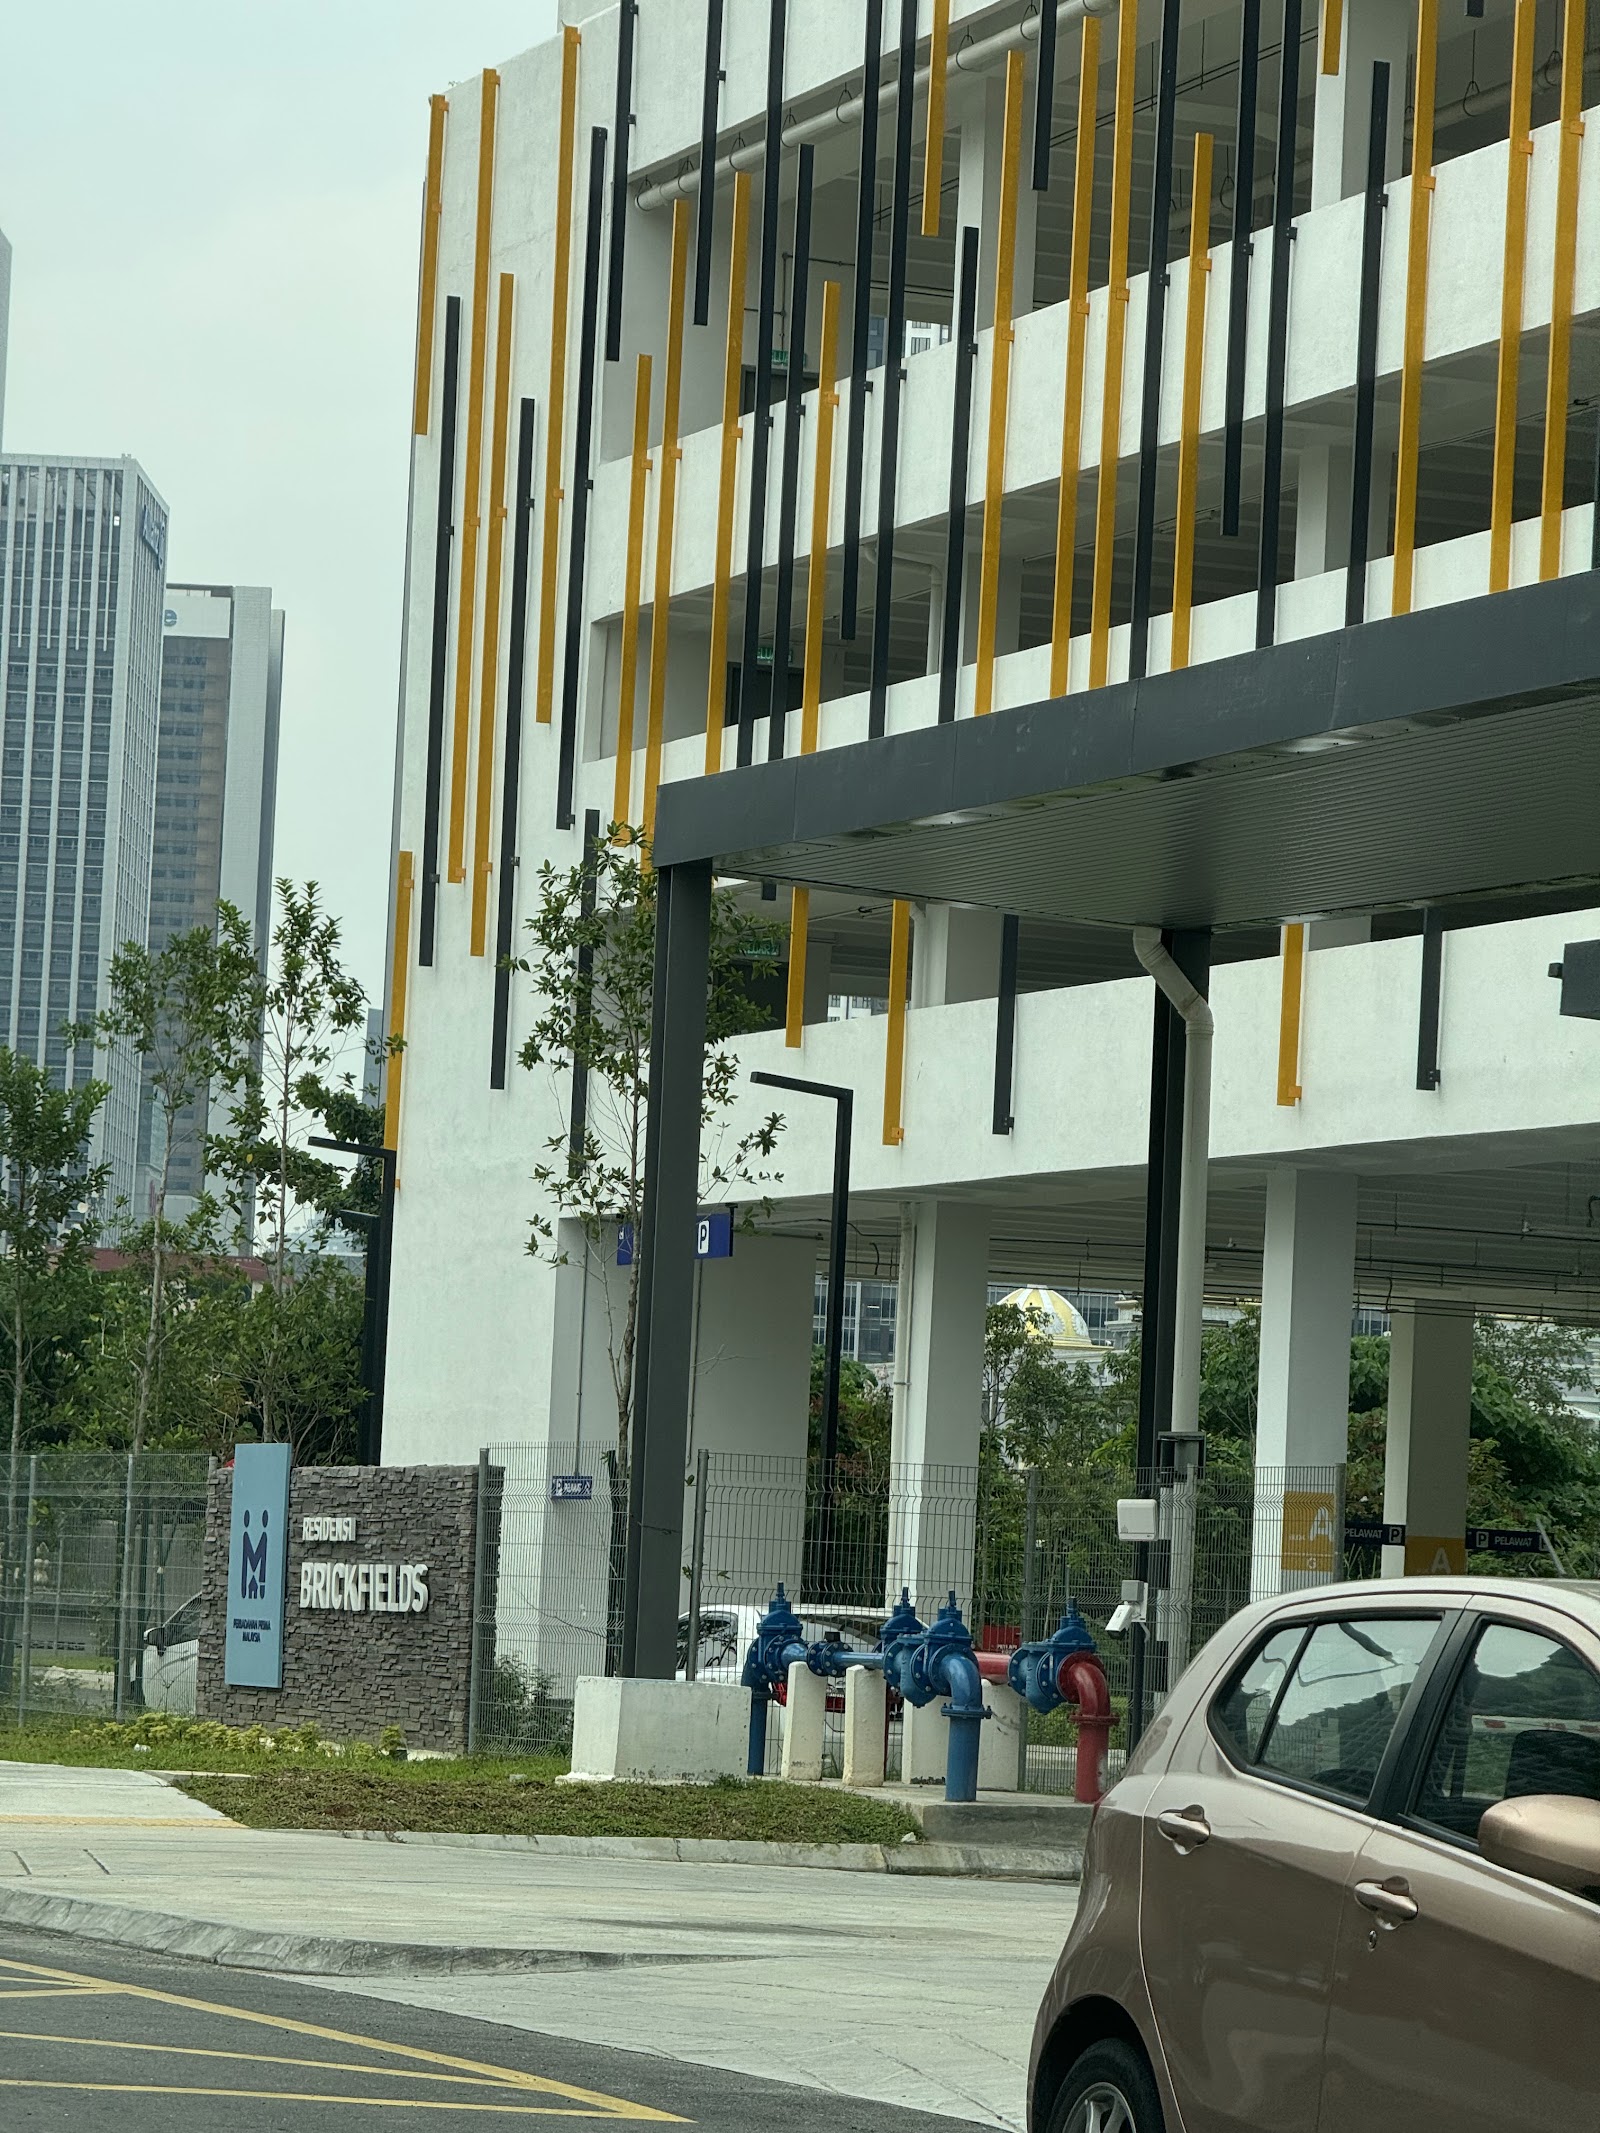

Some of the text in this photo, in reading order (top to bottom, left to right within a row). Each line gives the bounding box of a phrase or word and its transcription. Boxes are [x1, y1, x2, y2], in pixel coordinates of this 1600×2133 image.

[699, 1222, 708, 1252] P
[302, 1517, 356, 1541] RESIDENSI
[1309, 1507, 1332, 1541] A
[1344, 1527, 1401, 1542] PELAWAT P
[1477, 1532, 1487, 1546] P
[1494, 1536, 1533, 1547] PELAWAT
[1431, 1547, 1451, 1575] A
[300, 1562, 429, 1612] BRICKFIELDS
